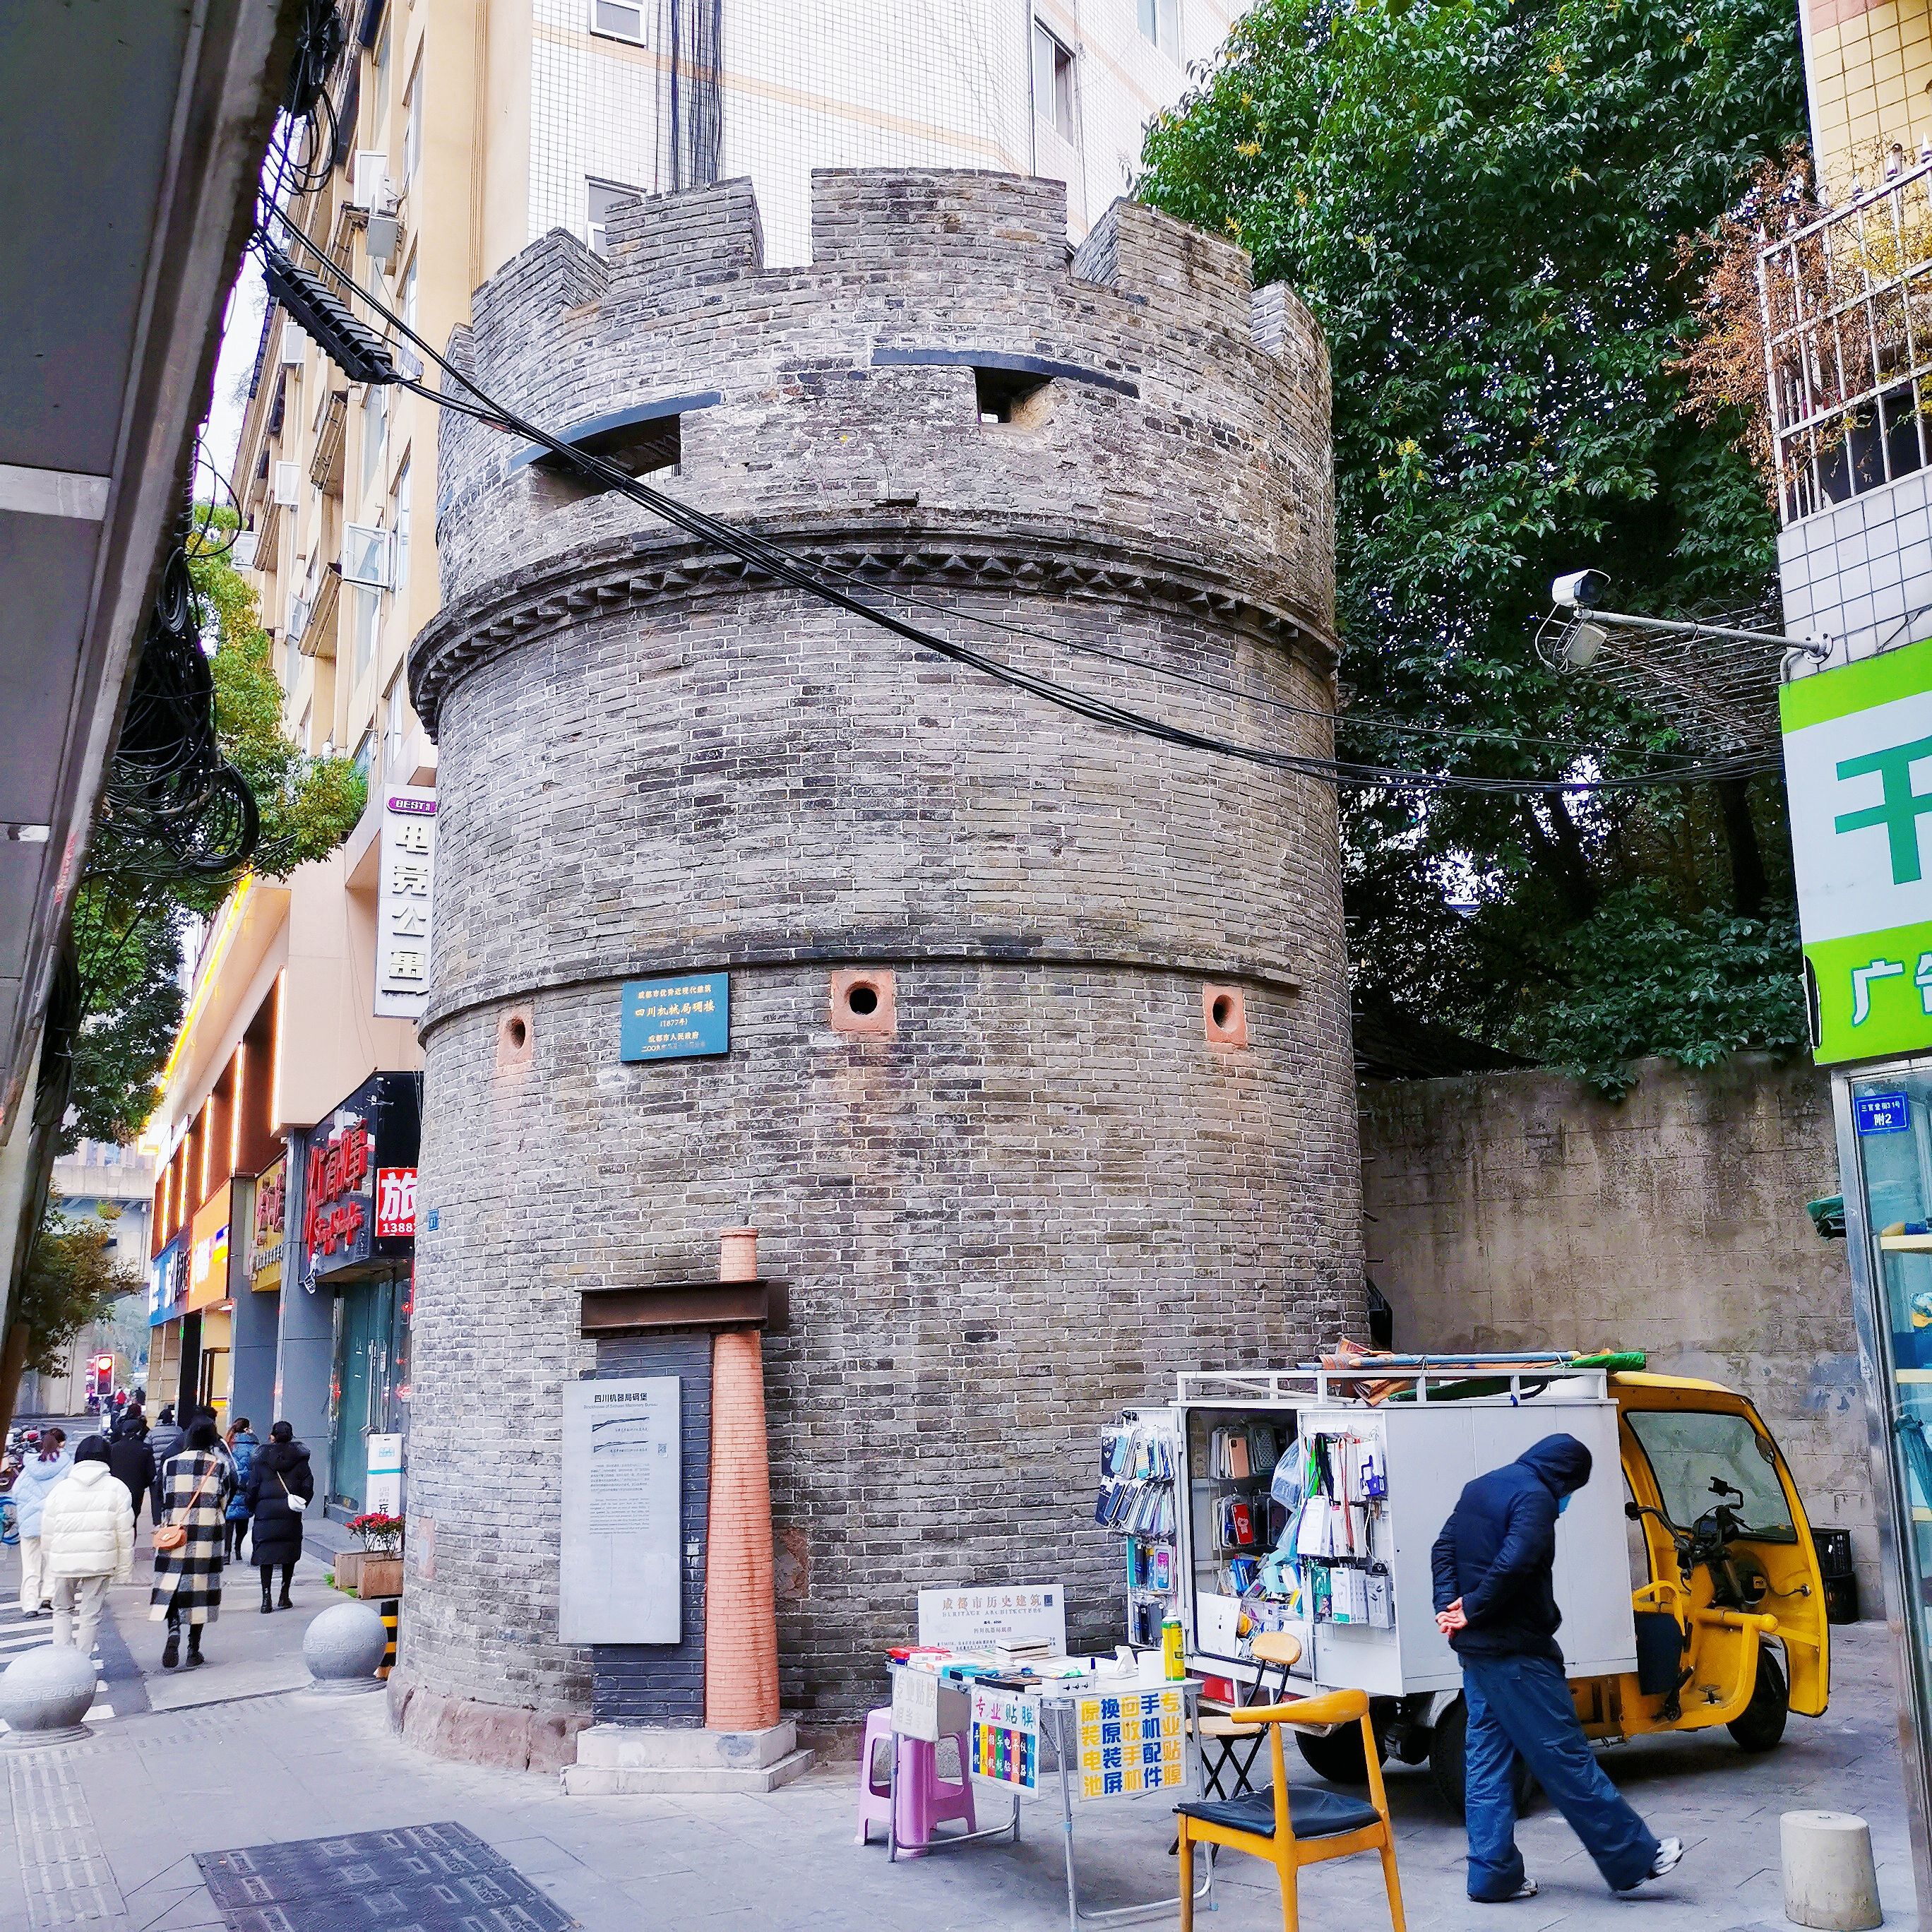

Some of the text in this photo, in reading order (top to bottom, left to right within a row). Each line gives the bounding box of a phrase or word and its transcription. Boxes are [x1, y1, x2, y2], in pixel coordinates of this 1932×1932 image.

[395, 799, 425, 810] BEST
[648, 1031, 699, 1042] 成都市人民政府
[1873, 1113, 1892, 1126] 附2
[379, 1171, 417, 1221] 旅
[383, 1222, 415, 1233] 1388
[594, 1393, 648, 1402] 四川机器局碉堡
[942, 1594, 1042, 1610] 成都市历史建筑
[975, 1695, 1035, 1729] 专业贴膜
[1081, 1700, 1102, 1797] 原装电池
[1101, 1698, 1123, 1794] 换原装屏
[1121, 1696, 1142, 1791] 回收手机
[1140, 1693, 1162, 1789] 手机配件
[1160, 1692, 1182, 1785] 专业贴膜
